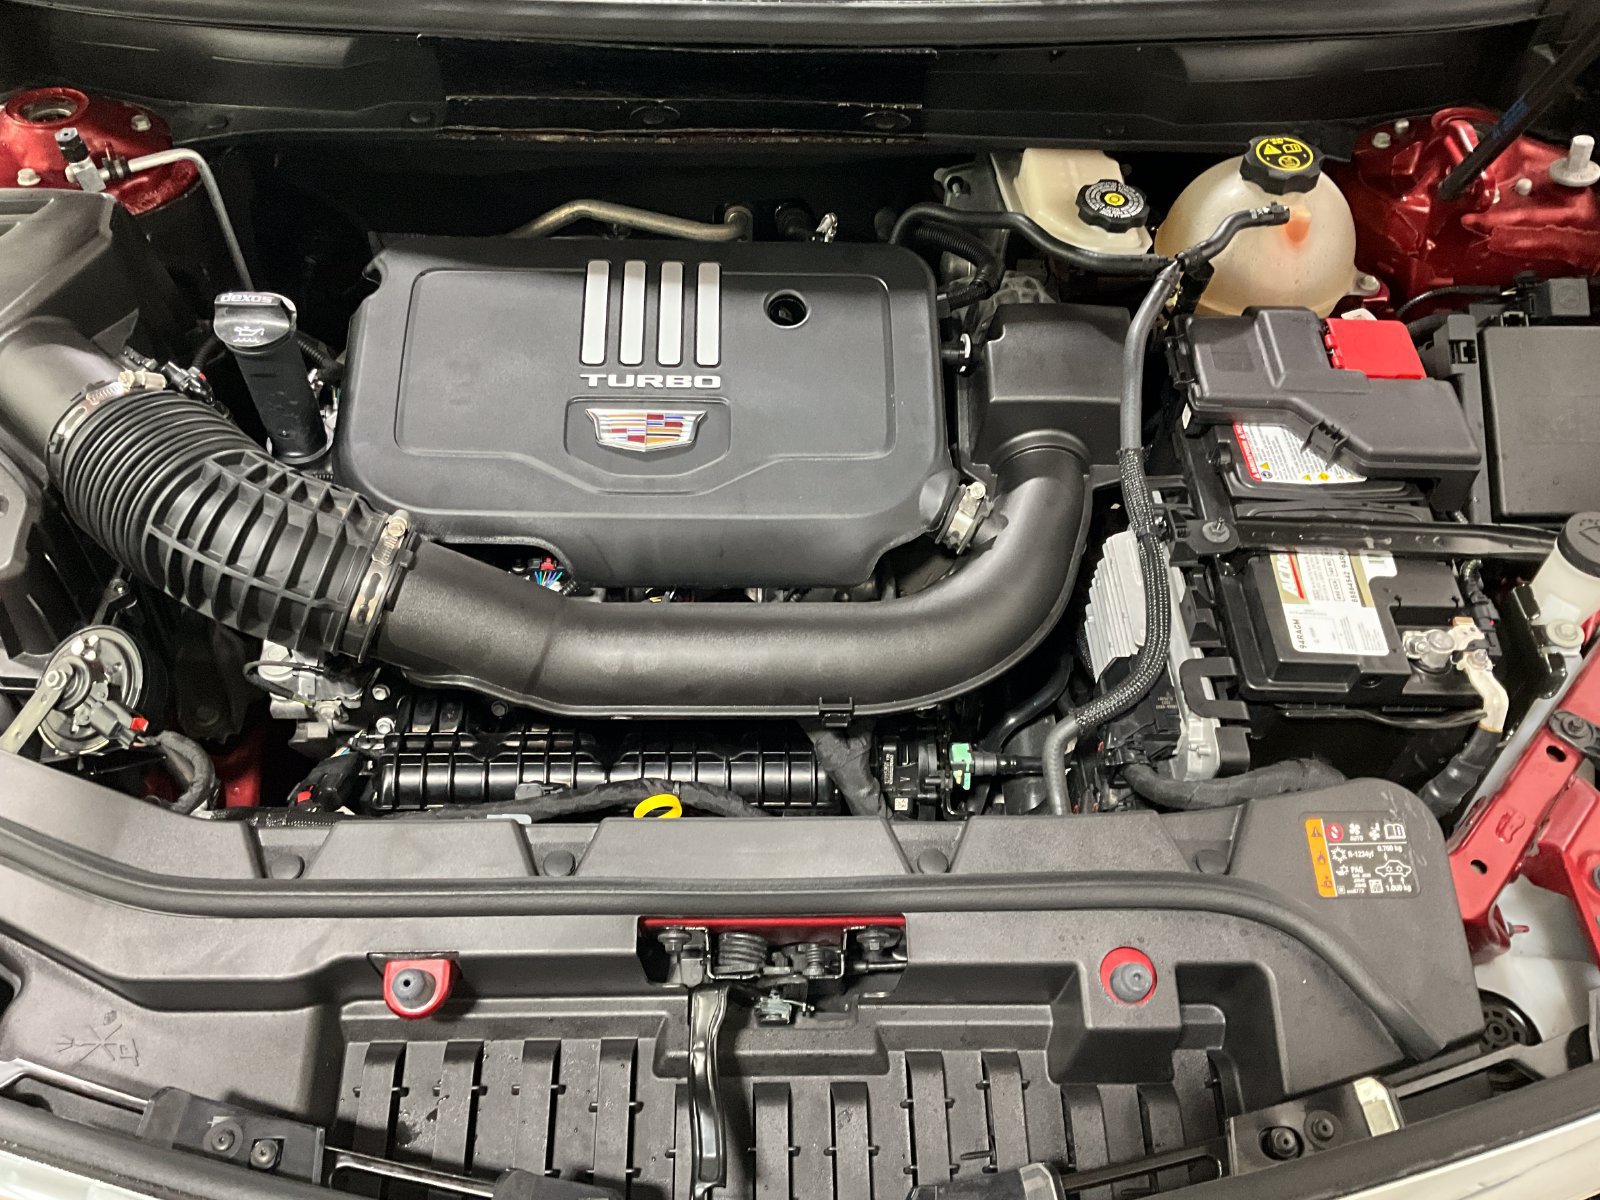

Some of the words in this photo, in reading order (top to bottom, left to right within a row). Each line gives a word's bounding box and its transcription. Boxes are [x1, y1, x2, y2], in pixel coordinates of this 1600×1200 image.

[220, 293, 274, 303] dexos
[580, 374, 721, 388] TURBO
[1293, 618, 1307, 649] 94RAGM
